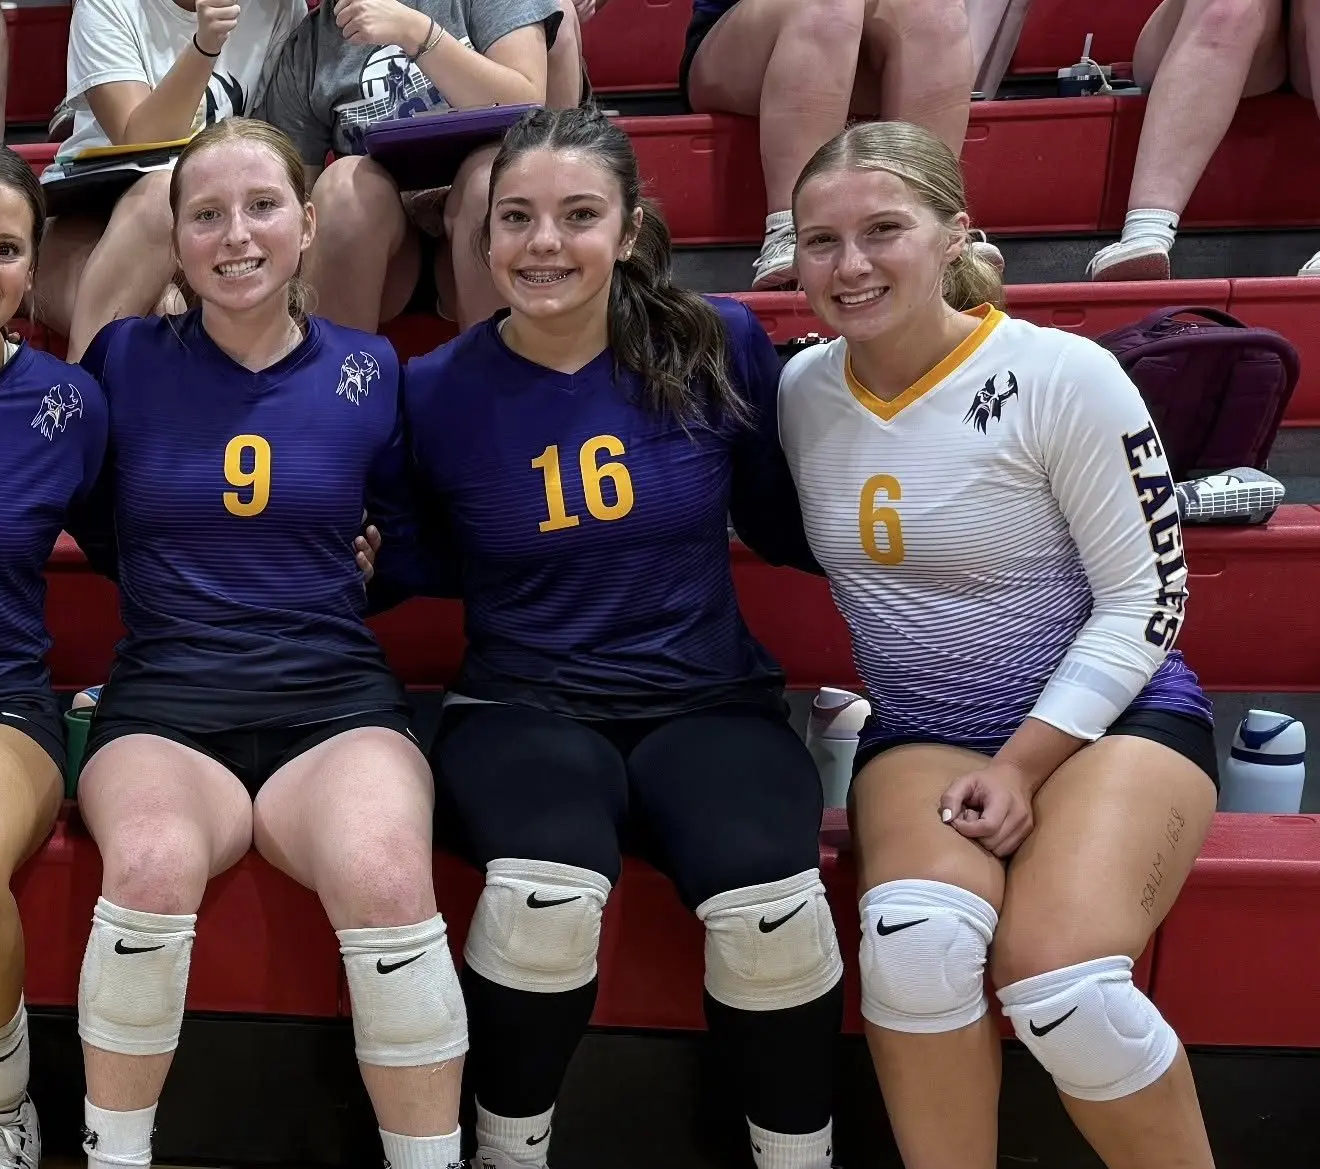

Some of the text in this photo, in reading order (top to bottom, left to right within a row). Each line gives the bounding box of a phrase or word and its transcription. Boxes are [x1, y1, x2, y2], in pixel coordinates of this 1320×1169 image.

[223, 434, 272, 518] 9
[530, 434, 634, 533] 16
[858, 473, 906, 566] 6
[1120, 420, 1189, 653] EAGLES
[1140, 852, 1167, 916] PSALM
